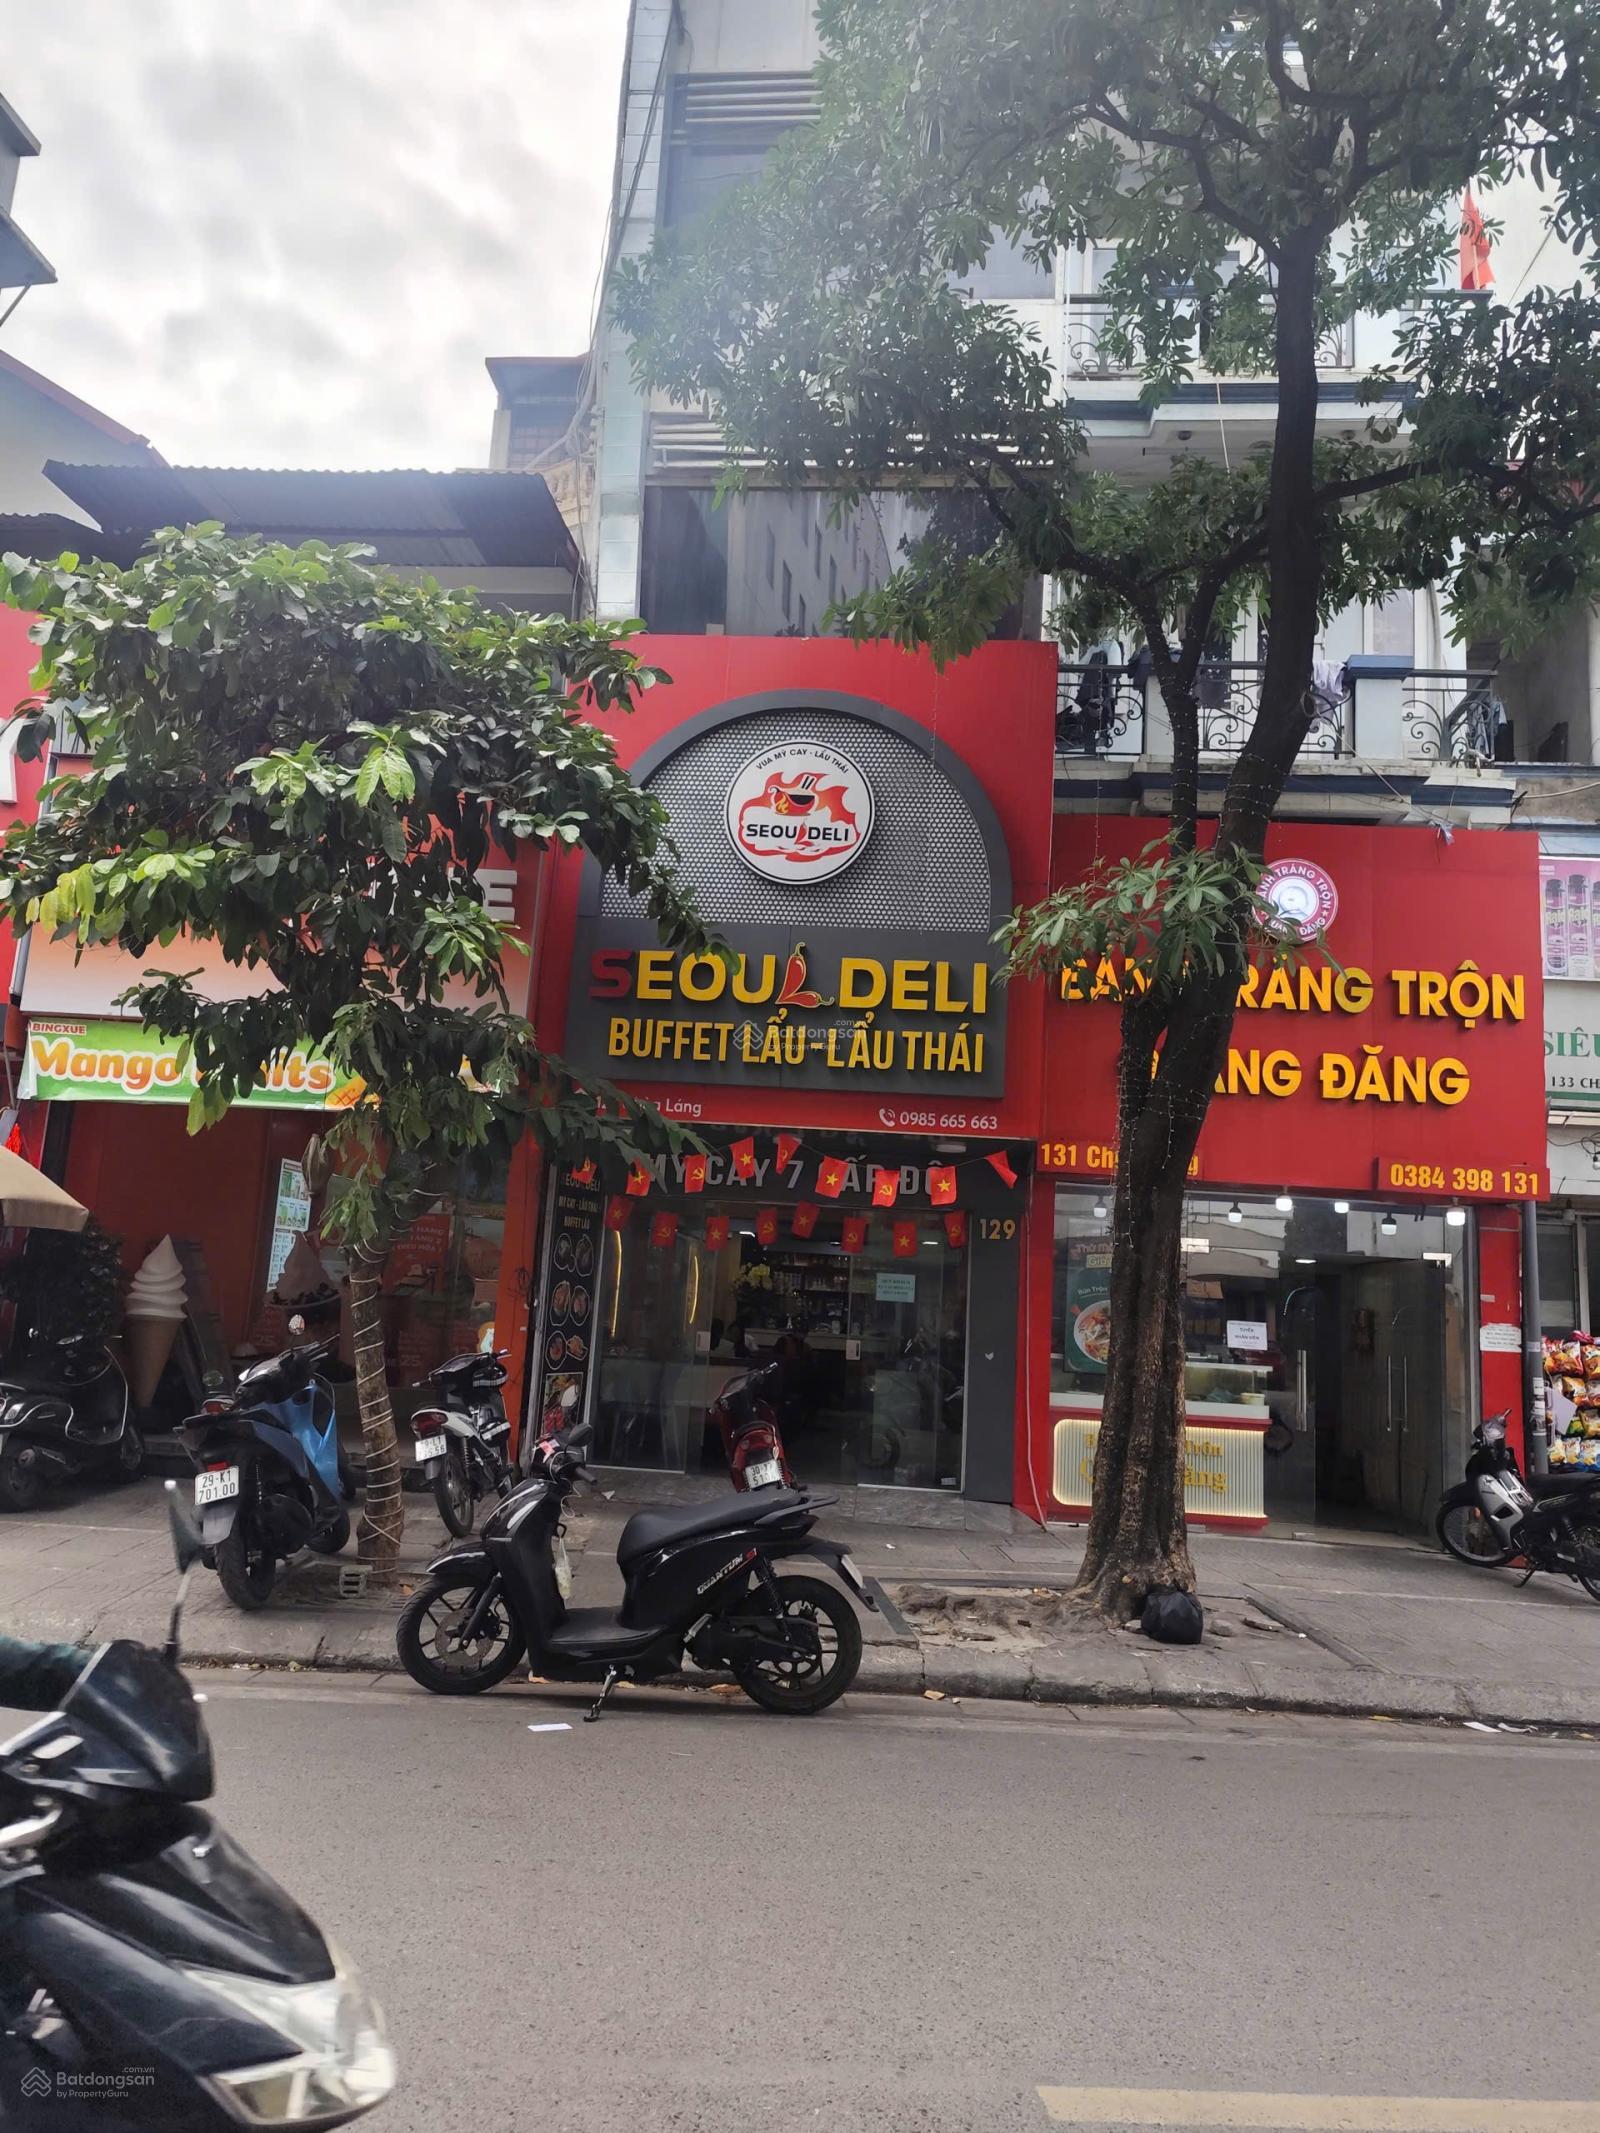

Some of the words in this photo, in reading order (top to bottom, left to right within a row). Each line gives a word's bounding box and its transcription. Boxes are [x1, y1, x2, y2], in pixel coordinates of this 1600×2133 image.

[756, 757, 774, 770] VUA
[831, 758, 849, 774] THÁI
[807, 826, 849, 841] DELI
[1274, 864, 1316, 879] TRÁNG
[838, 957, 988, 1014] DELI
[1236, 954, 1374, 1014] RÁNG
[1392, 959, 1525, 1029] TRỘN
[32, 1023, 86, 1035] BINGXUE
[608, 1017, 734, 1062] BUFFET
[903, 1022, 984, 1072] THÁI
[32, 1040, 181, 1089] Mango
[1320, 1044, 1470, 1105] ĐĂNG
[1552, 1076, 1575, 1088] 133
[665, 1098, 702, 1117] Láng
[900, 1111, 936, 1127] 0985
[940, 1114, 966, 1128] 665
[971, 1116, 998, 1130] 663
[1041, 1143, 1078, 1167] 131
[787, 1160, 804, 1189] 7
[1390, 1163, 1446, 1189] 0384
[1452, 1167, 1494, 1192] 398
[1501, 1171, 1539, 1195] 131
[979, 1218, 1016, 1240] 129
[202, 1470, 231, 1489] 29-K1
[1185, 1465, 1228, 1494] ăng
[199, 1482, 236, 1503] 701.00
